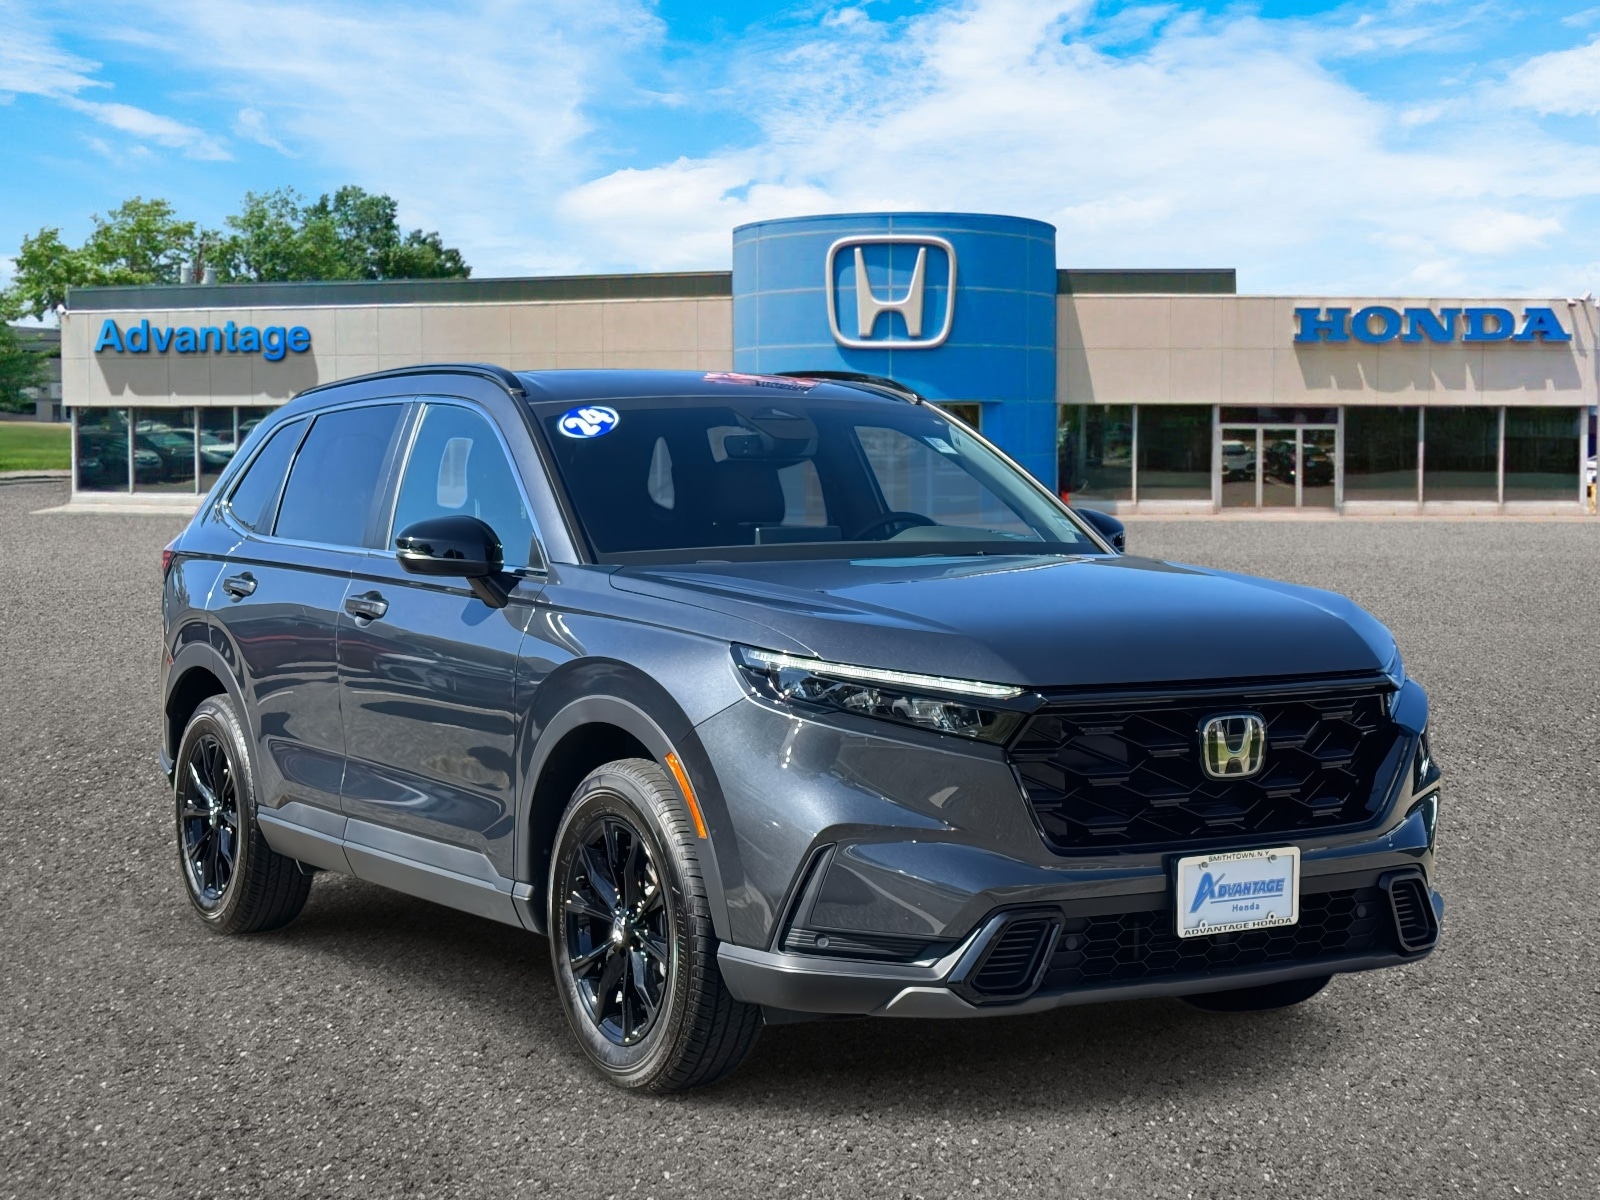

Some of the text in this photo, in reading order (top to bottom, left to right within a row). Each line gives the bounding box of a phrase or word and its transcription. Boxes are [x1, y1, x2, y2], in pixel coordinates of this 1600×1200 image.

[94, 318, 311, 361] Advantage
[1294, 305, 1572, 343] HONDA
[564, 408, 615, 436] 24
[1189, 871, 1286, 913] ADVANTAGE
[1232, 901, 1260, 912] Honda
[1184, 917, 1292, 936] ADVANTAGE HONDA
